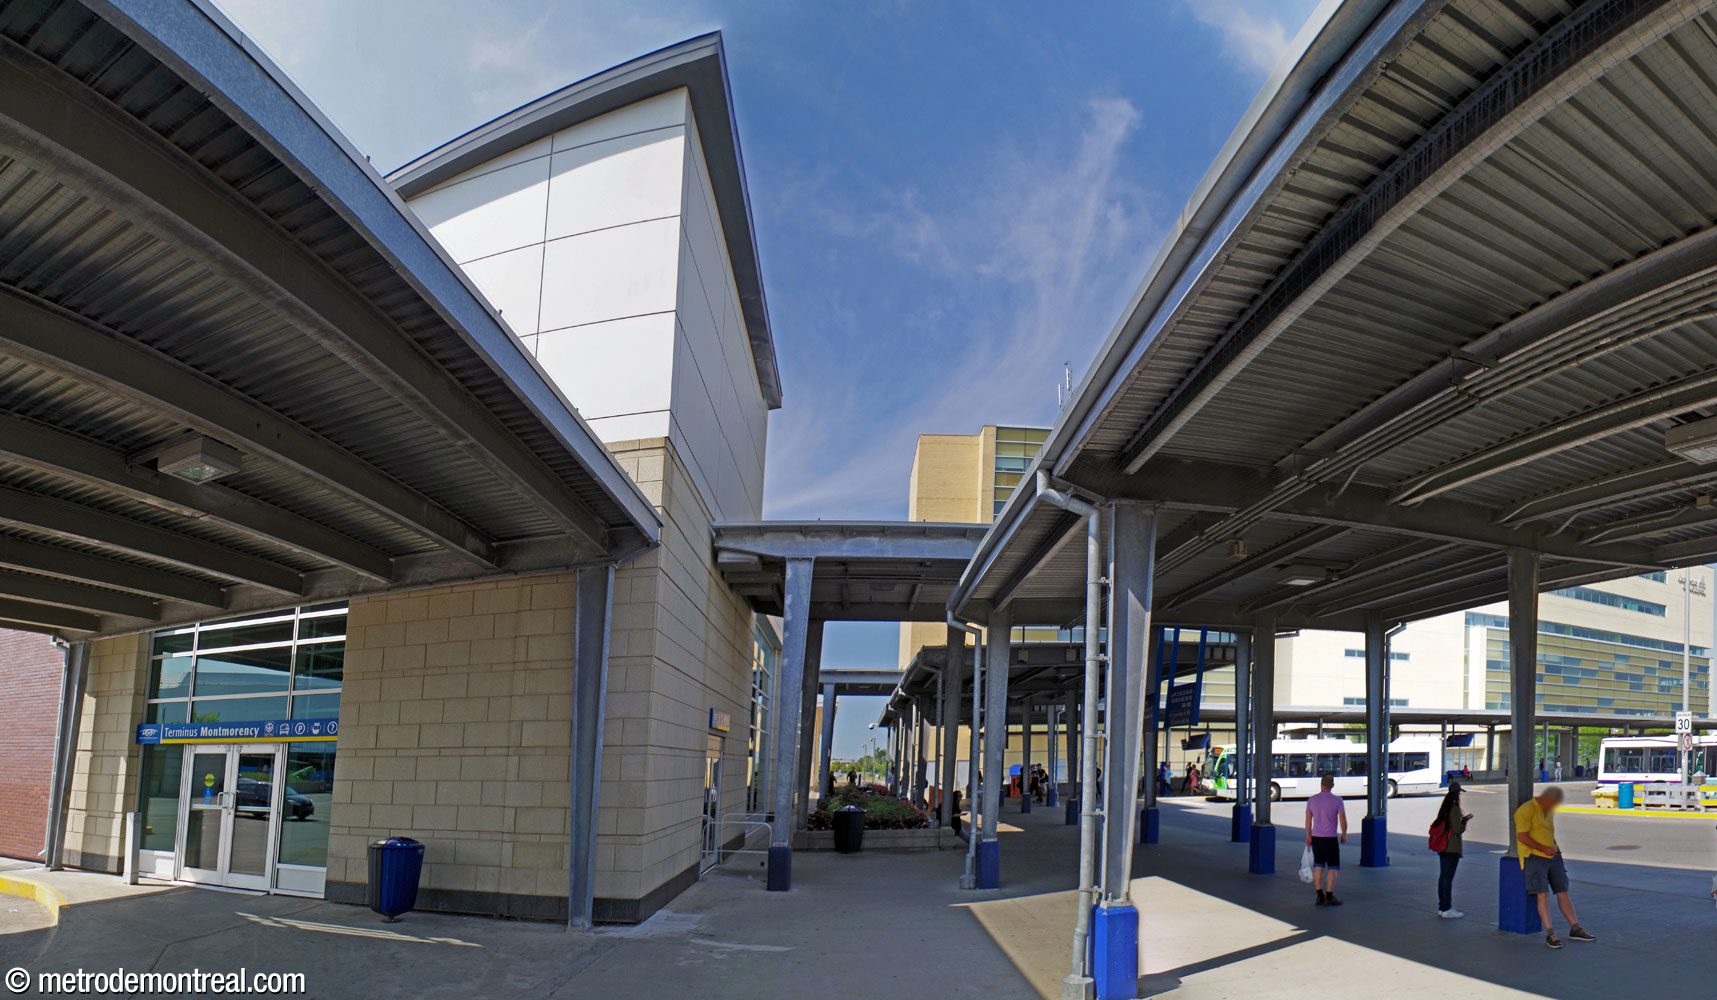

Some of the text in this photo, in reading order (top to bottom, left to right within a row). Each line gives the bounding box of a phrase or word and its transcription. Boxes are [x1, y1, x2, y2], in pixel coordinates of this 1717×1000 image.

[1677, 718, 1690, 730] 30
[164, 727, 198, 738] Terminus
[200, 725, 260, 738] Montmorency
